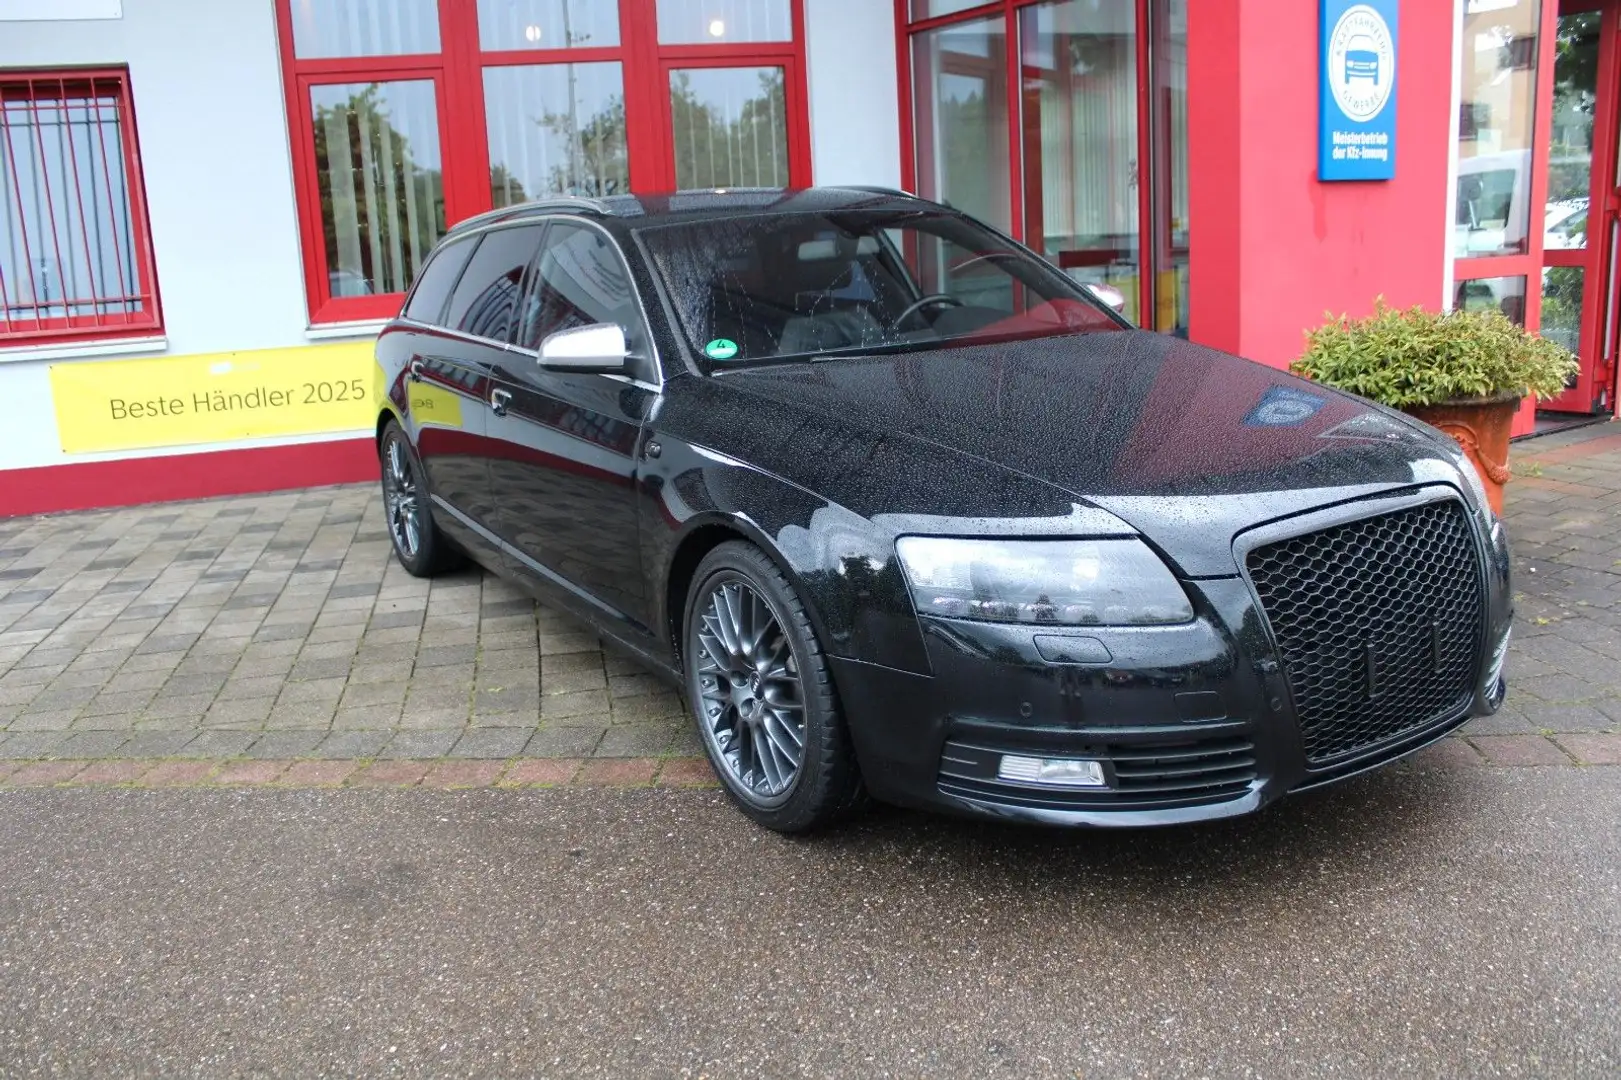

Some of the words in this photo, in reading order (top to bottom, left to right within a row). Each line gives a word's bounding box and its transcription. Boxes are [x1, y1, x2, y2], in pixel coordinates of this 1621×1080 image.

[1332, 131, 1388, 145] Meisterbetrieb
[1332, 146, 1346, 160] der
[717, 340, 725, 348] 4
[110, 396, 185, 420] Beste
[193, 387, 296, 413] Händler
[302, 378, 366, 404] 2025
